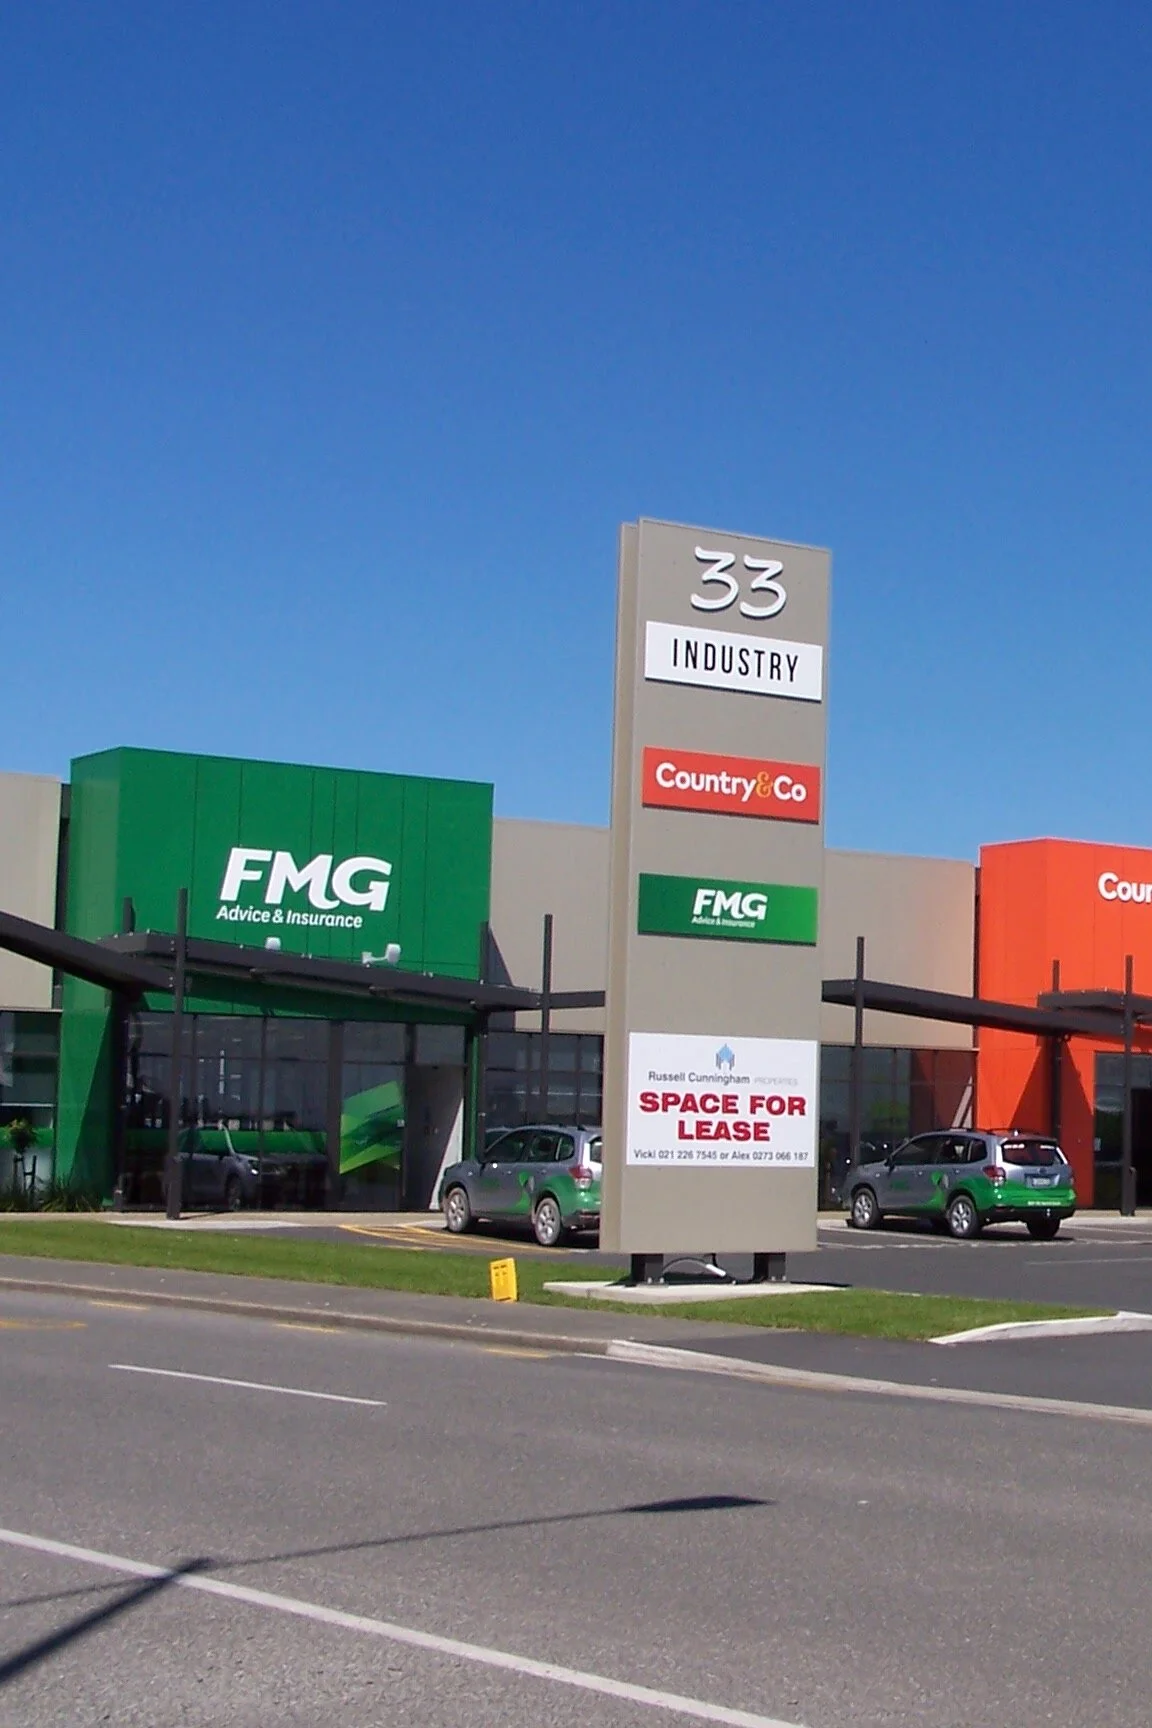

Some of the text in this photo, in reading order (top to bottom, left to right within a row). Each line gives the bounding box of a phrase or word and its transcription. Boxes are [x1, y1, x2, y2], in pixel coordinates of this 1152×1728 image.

[690, 546, 788, 620] 33
[673, 638, 799, 683] INDUSTRY
[655, 762, 807, 802] Country&Co
[220, 847, 393, 912] FMG
[216, 904, 363, 929] Advice & Insurance
[693, 888, 768, 920] FMG
[648, 1071, 685, 1083] Russell
[688, 1072, 750, 1086] Cunningham
[639, 1091, 806, 1116] SPACE FOR
[677, 1120, 770, 1142] LEASE
[633, 1149, 656, 1159] Vicki
[658, 1150, 675, 1160] 021
[719, 1152, 729, 1160] or
[731, 1150, 750, 1160] Alex
